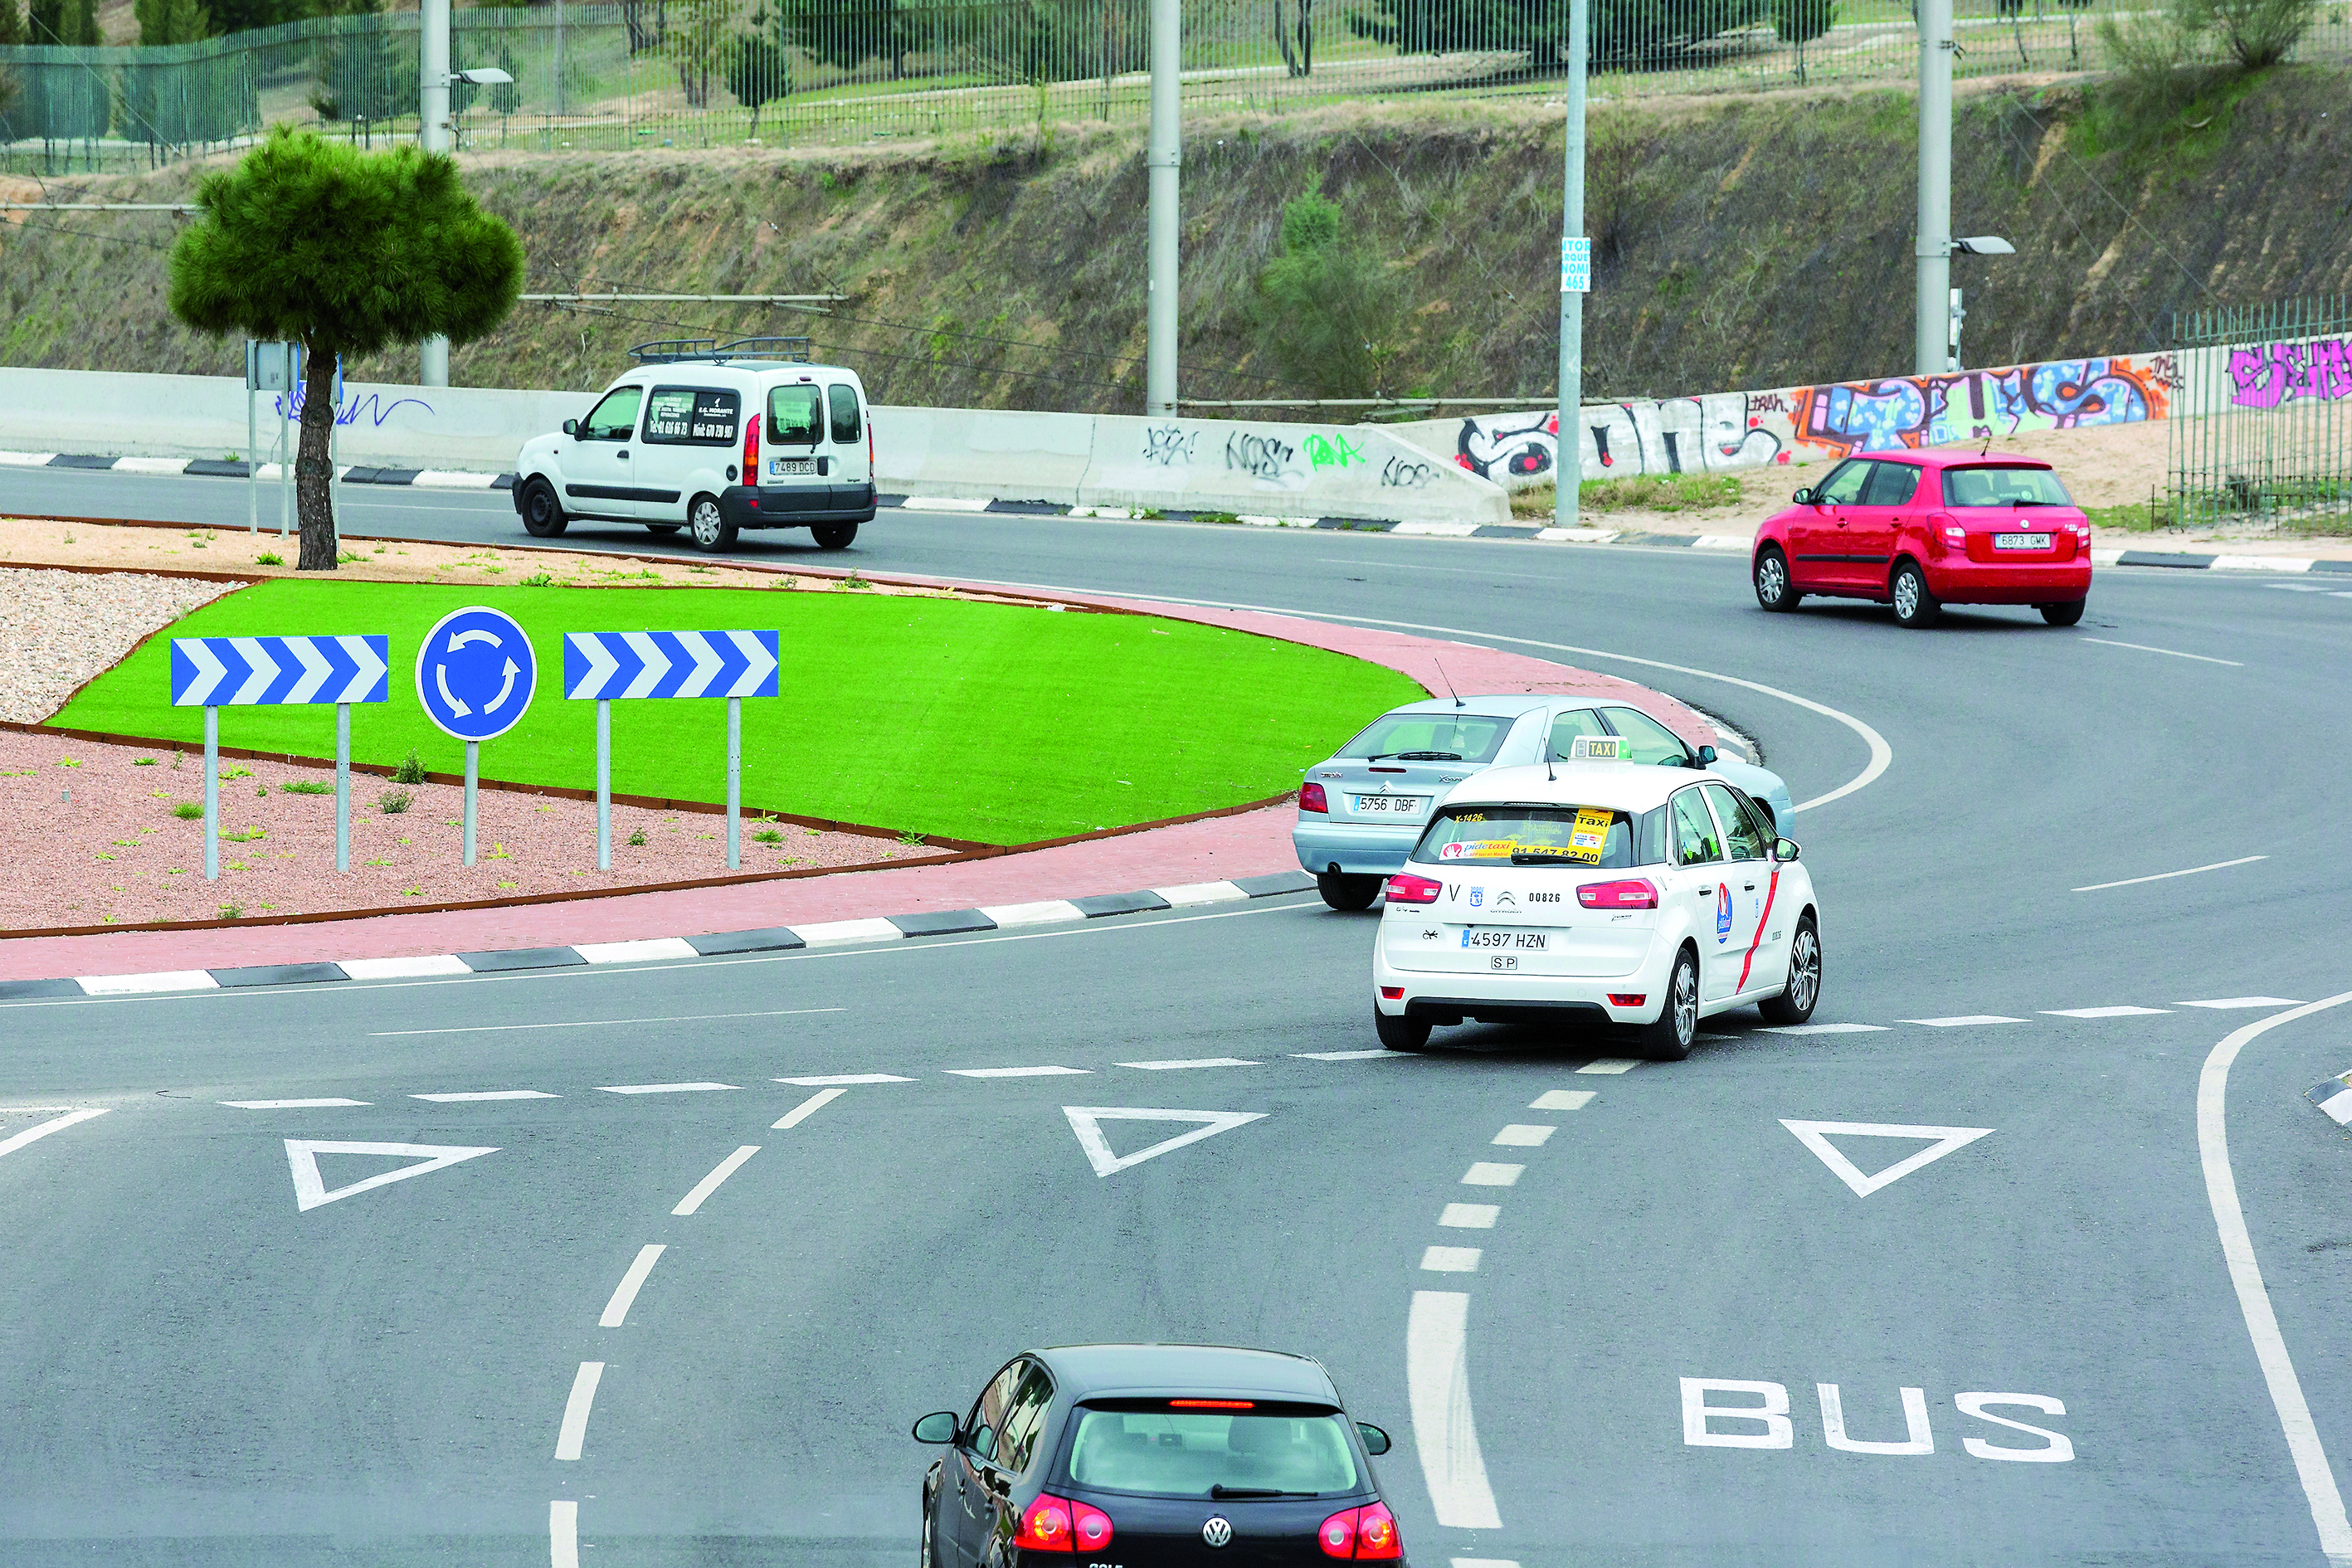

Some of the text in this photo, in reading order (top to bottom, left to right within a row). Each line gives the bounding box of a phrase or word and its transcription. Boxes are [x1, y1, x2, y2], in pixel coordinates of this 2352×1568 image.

[776, 461, 796, 472] 7489
[2002, 535, 2047, 546] 6873 GWK
[1590, 743, 1615, 756] TAXI
[1360, 796, 1416, 812] 5756 DBF
[1454, 813, 1483, 824] X-1426
[1464, 842, 1512, 852] pidetaxi
[1449, 884, 1461, 902] V
[1528, 893, 1561, 903] 00826
[1472, 933, 1546, 948] 4597 HZN
[1679, 1376, 2075, 1463] BUS
